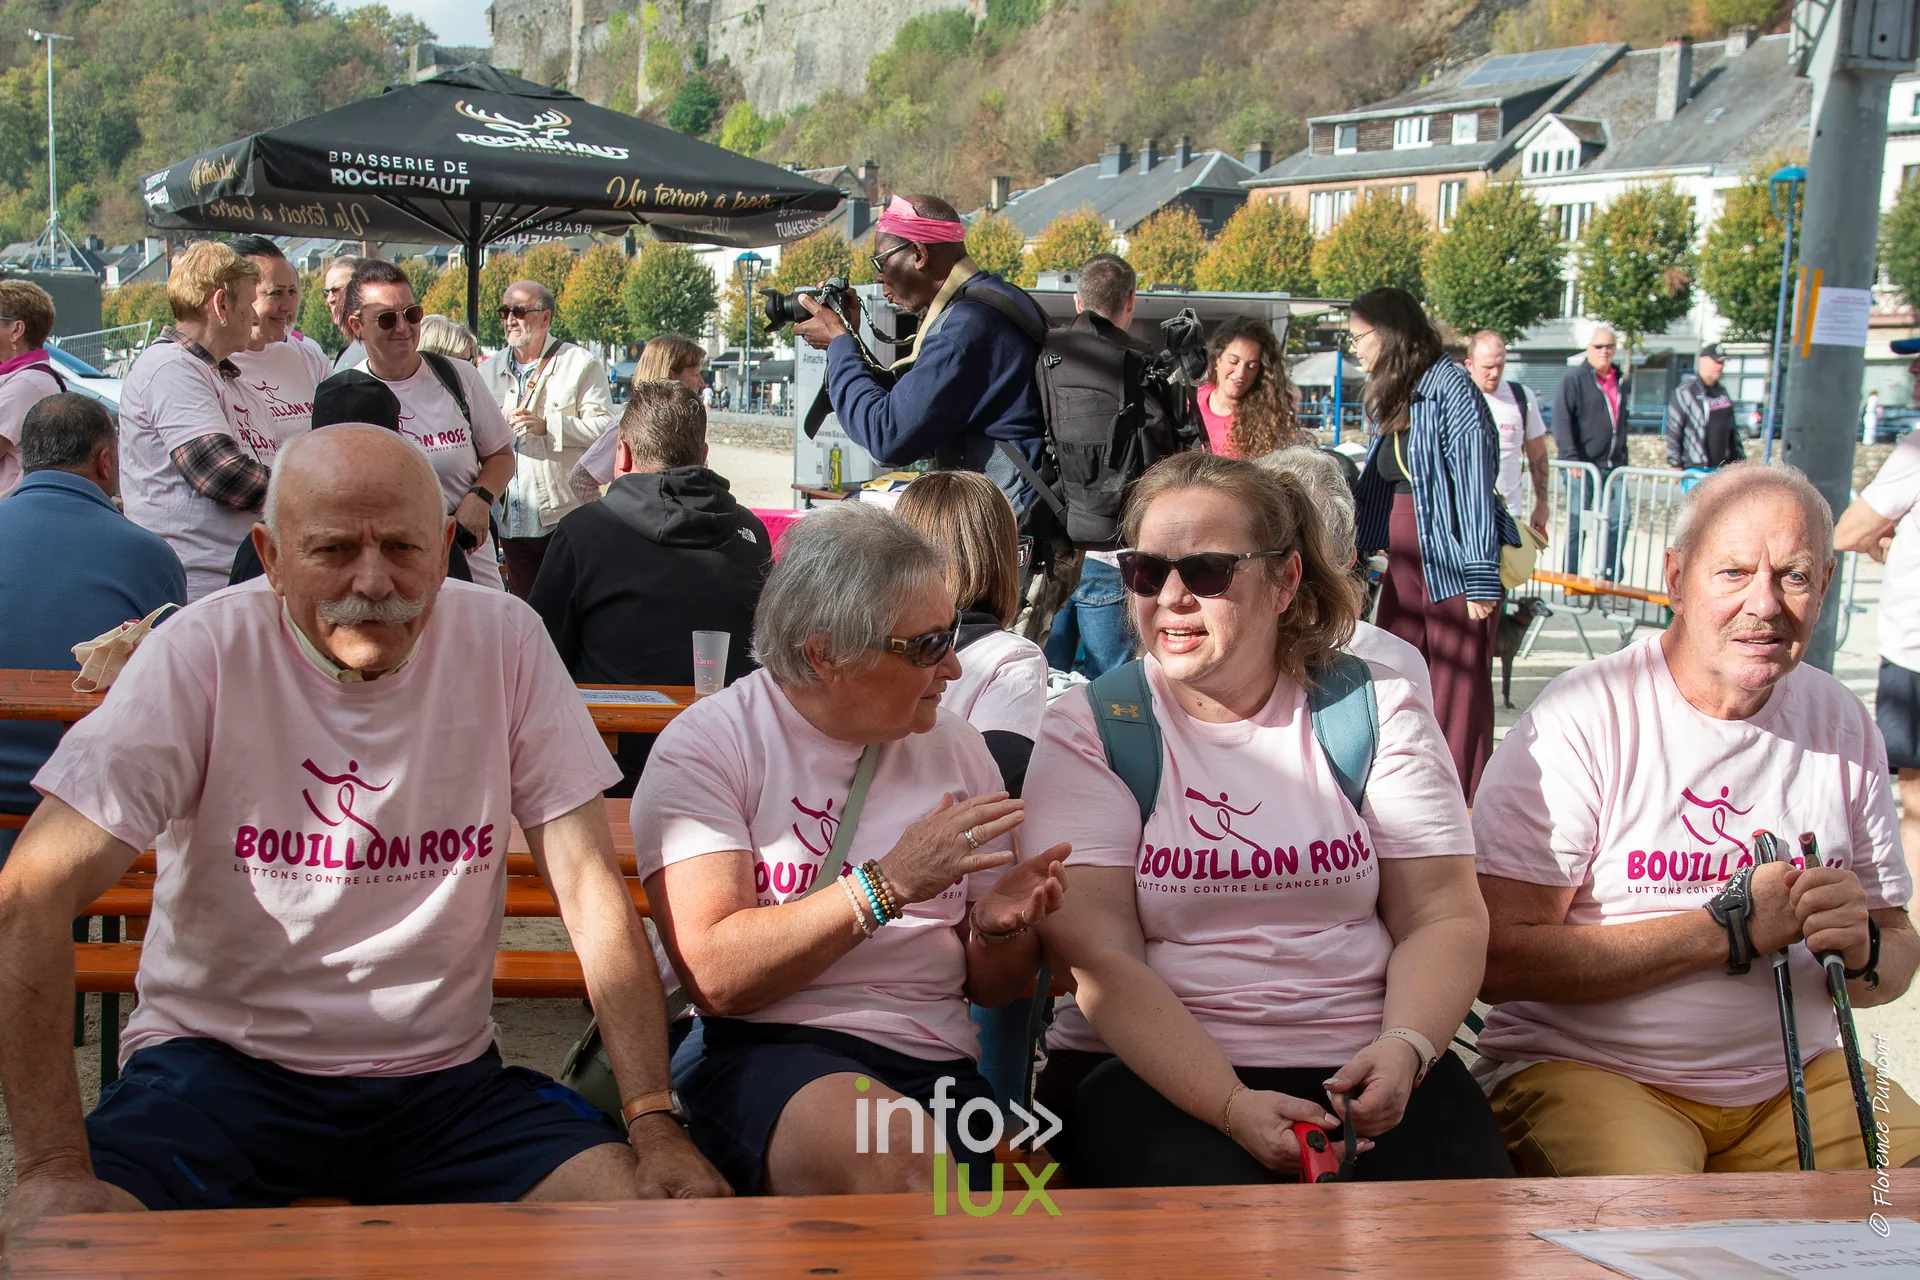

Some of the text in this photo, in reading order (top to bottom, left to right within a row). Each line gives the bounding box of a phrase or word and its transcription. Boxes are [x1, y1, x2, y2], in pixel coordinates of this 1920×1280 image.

[456, 132, 629, 160] ROCHEHAUT
[329, 150, 469, 174] BRASSERIE DE
[330, 168, 471, 195] ROCHEHAUT
[606, 175, 647, 209] Un
[654, 182, 708, 207] terroir
[713, 192, 726, 209] à
[438, 427, 467, 446] ROSE
[235, 823, 495, 871] BOUILLON ROSE
[1140, 829, 1371, 880] BOUILLON ROSE
[234, 862, 491, 886] LUTTONS CONTRE LE CANCER DU SEIN
[1137, 864, 1375, 894] LUTTONS CONTRE LE CANCER DU SEIN
[1627, 848, 1753, 883] BOUILL
[942, 890, 963, 900] SEIN
[1627, 885, 1682, 895] LUTTONS
[1777, 1261, 1849, 1274] moi
